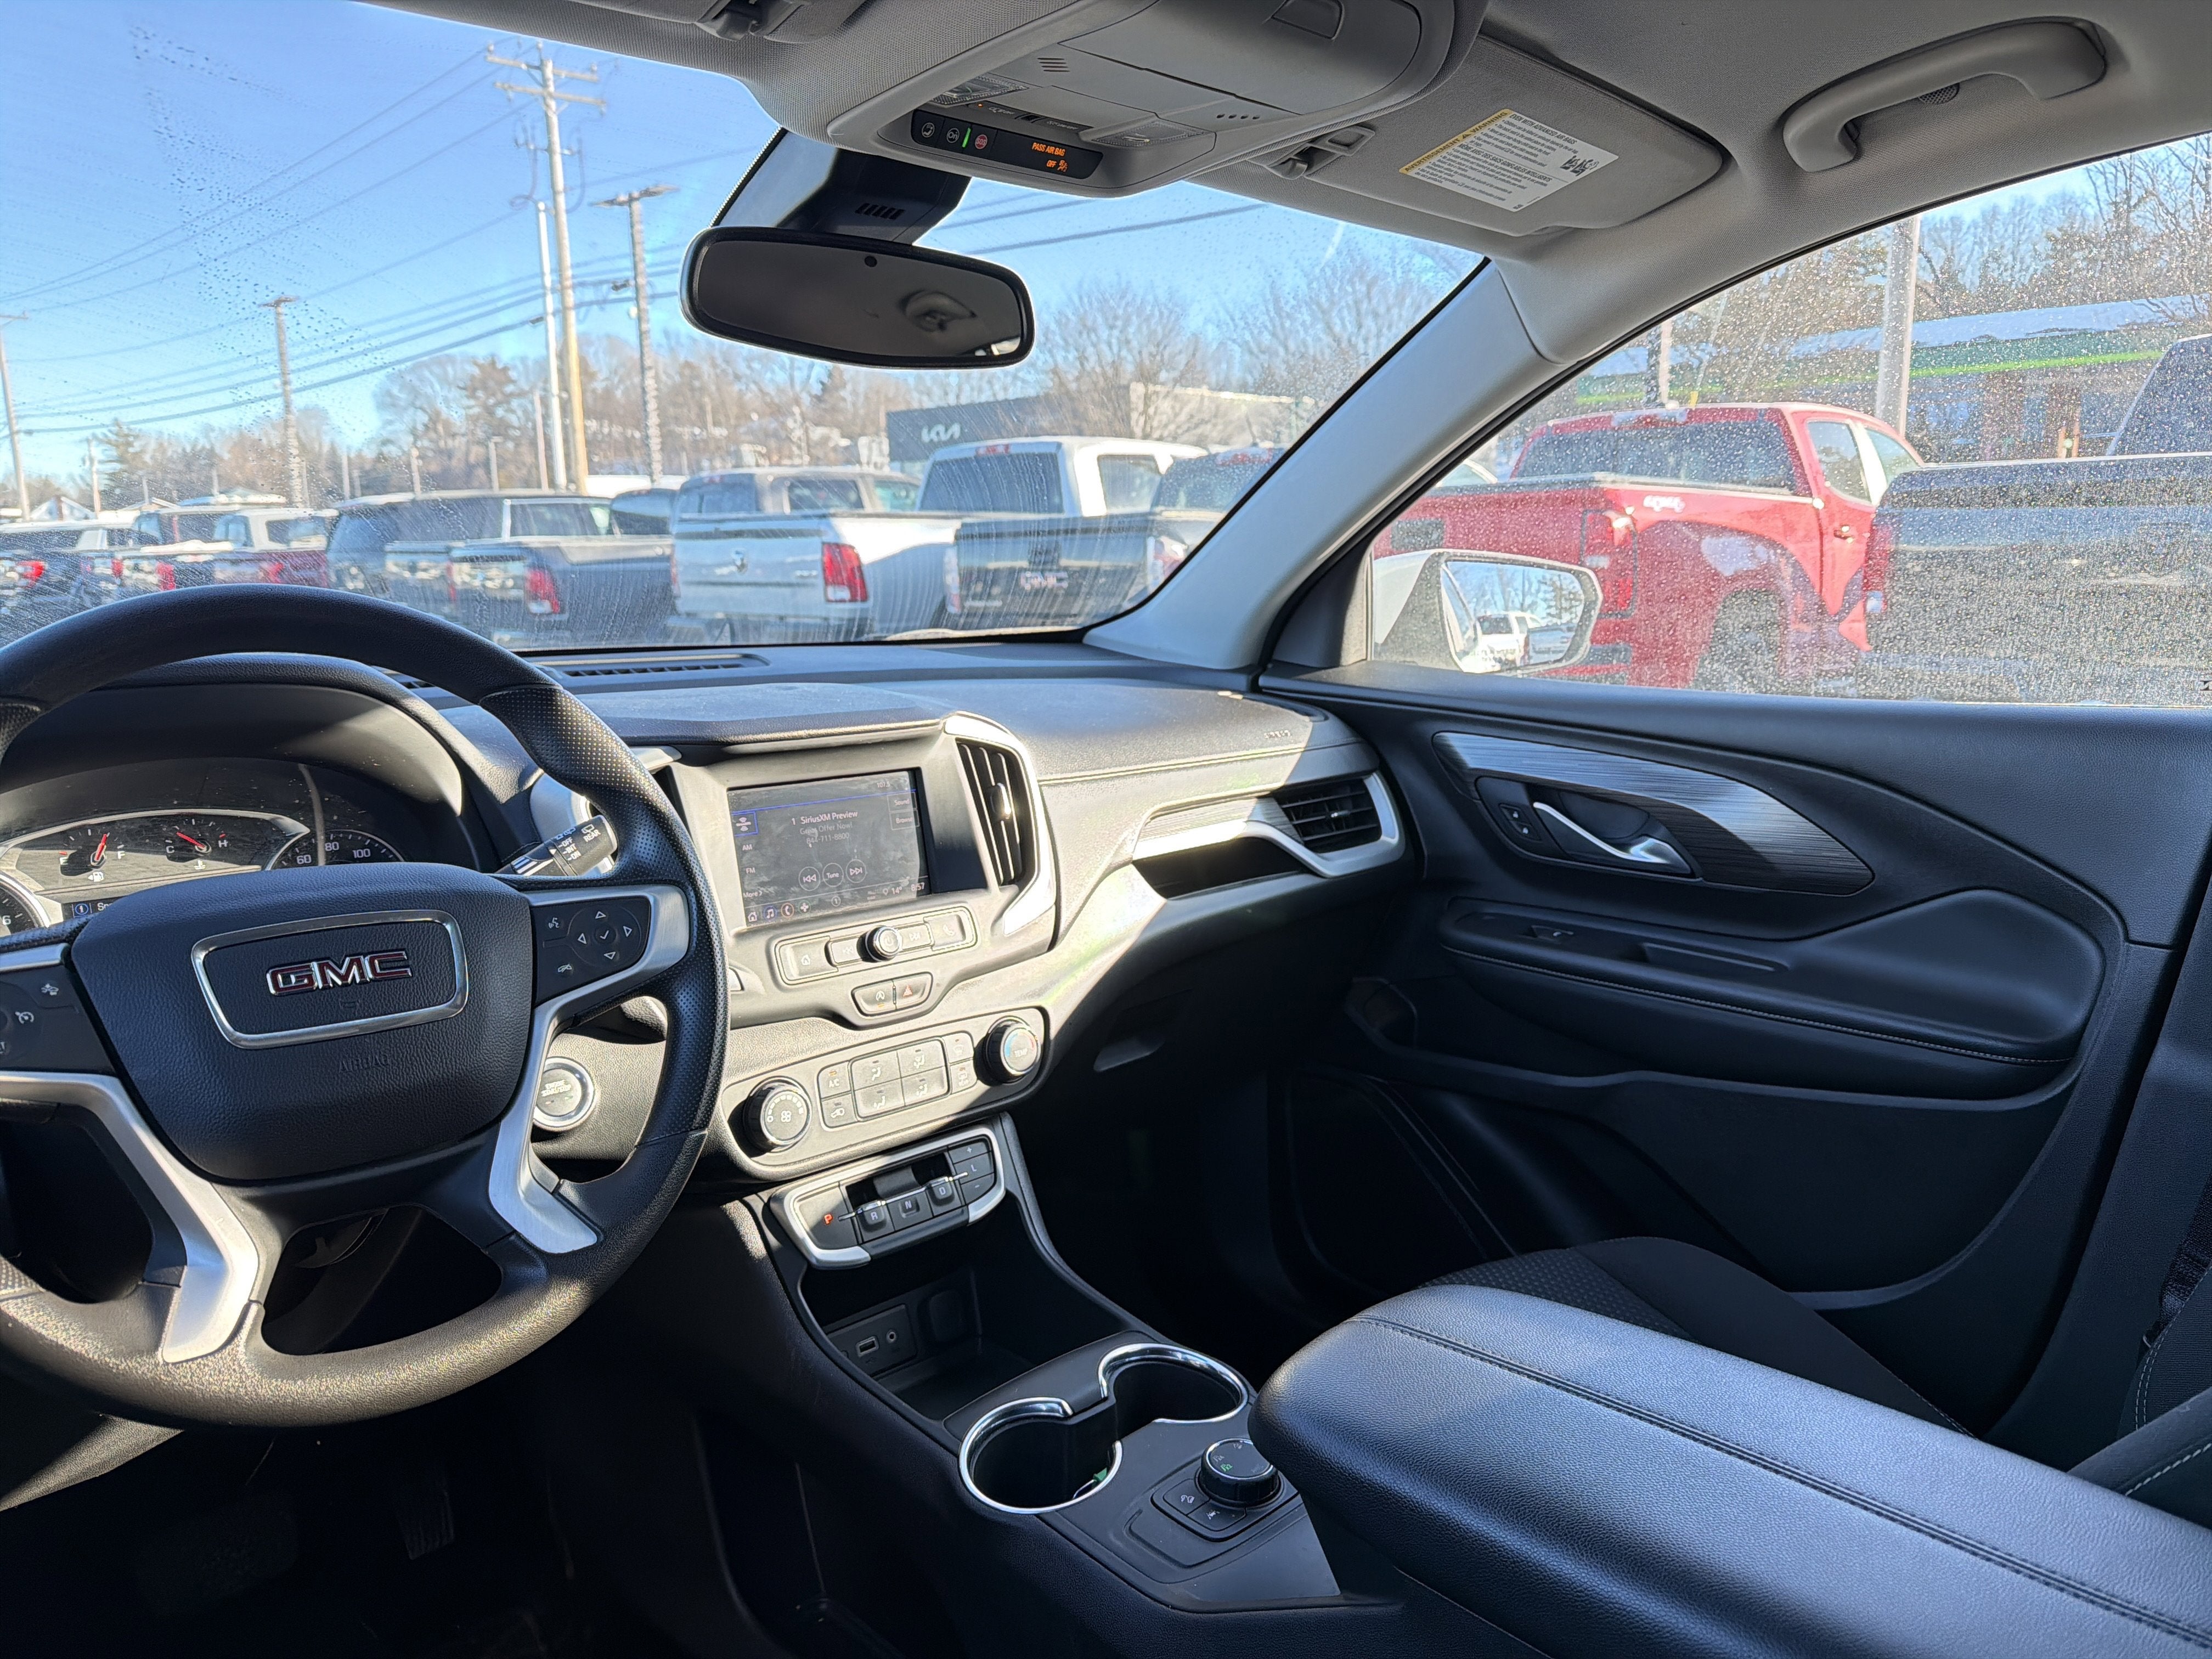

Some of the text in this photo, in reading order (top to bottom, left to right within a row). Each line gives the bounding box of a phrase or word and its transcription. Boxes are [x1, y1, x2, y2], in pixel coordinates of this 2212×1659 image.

[1470, 112, 1508, 133] WARNING
[1532, 123, 1559, 136] ADVANCED
[1032, 143, 1065, 156] PASS AIR BAG
[1404, 138, 1460, 172] AVERTISSEMENT
[800, 813, 831, 825] SiriusXM
[832, 810, 858, 821] Preview
[819, 824, 835, 832] Offer
[837, 821, 853, 831] Now!
[583, 829, 601, 842] REAR
[218, 840, 229, 848] H
[325, 842, 339, 851] 80
[562, 837, 573, 847] OFF
[166, 845, 175, 854] C
[565, 843, 577, 854] INT
[117, 851, 126, 860] F
[296, 854, 312, 864] 60
[352, 849, 371, 859] 100
[571, 850, 582, 860] ON
[59, 857, 68, 865] E
[2, 915, 11, 925] 6
[266, 951, 412, 995] GMC
[825, 1213, 833, 1224] P
[870, 1212, 878, 1221] R
[905, 1200, 912, 1209] N
[939, 1187, 947, 1195] D
